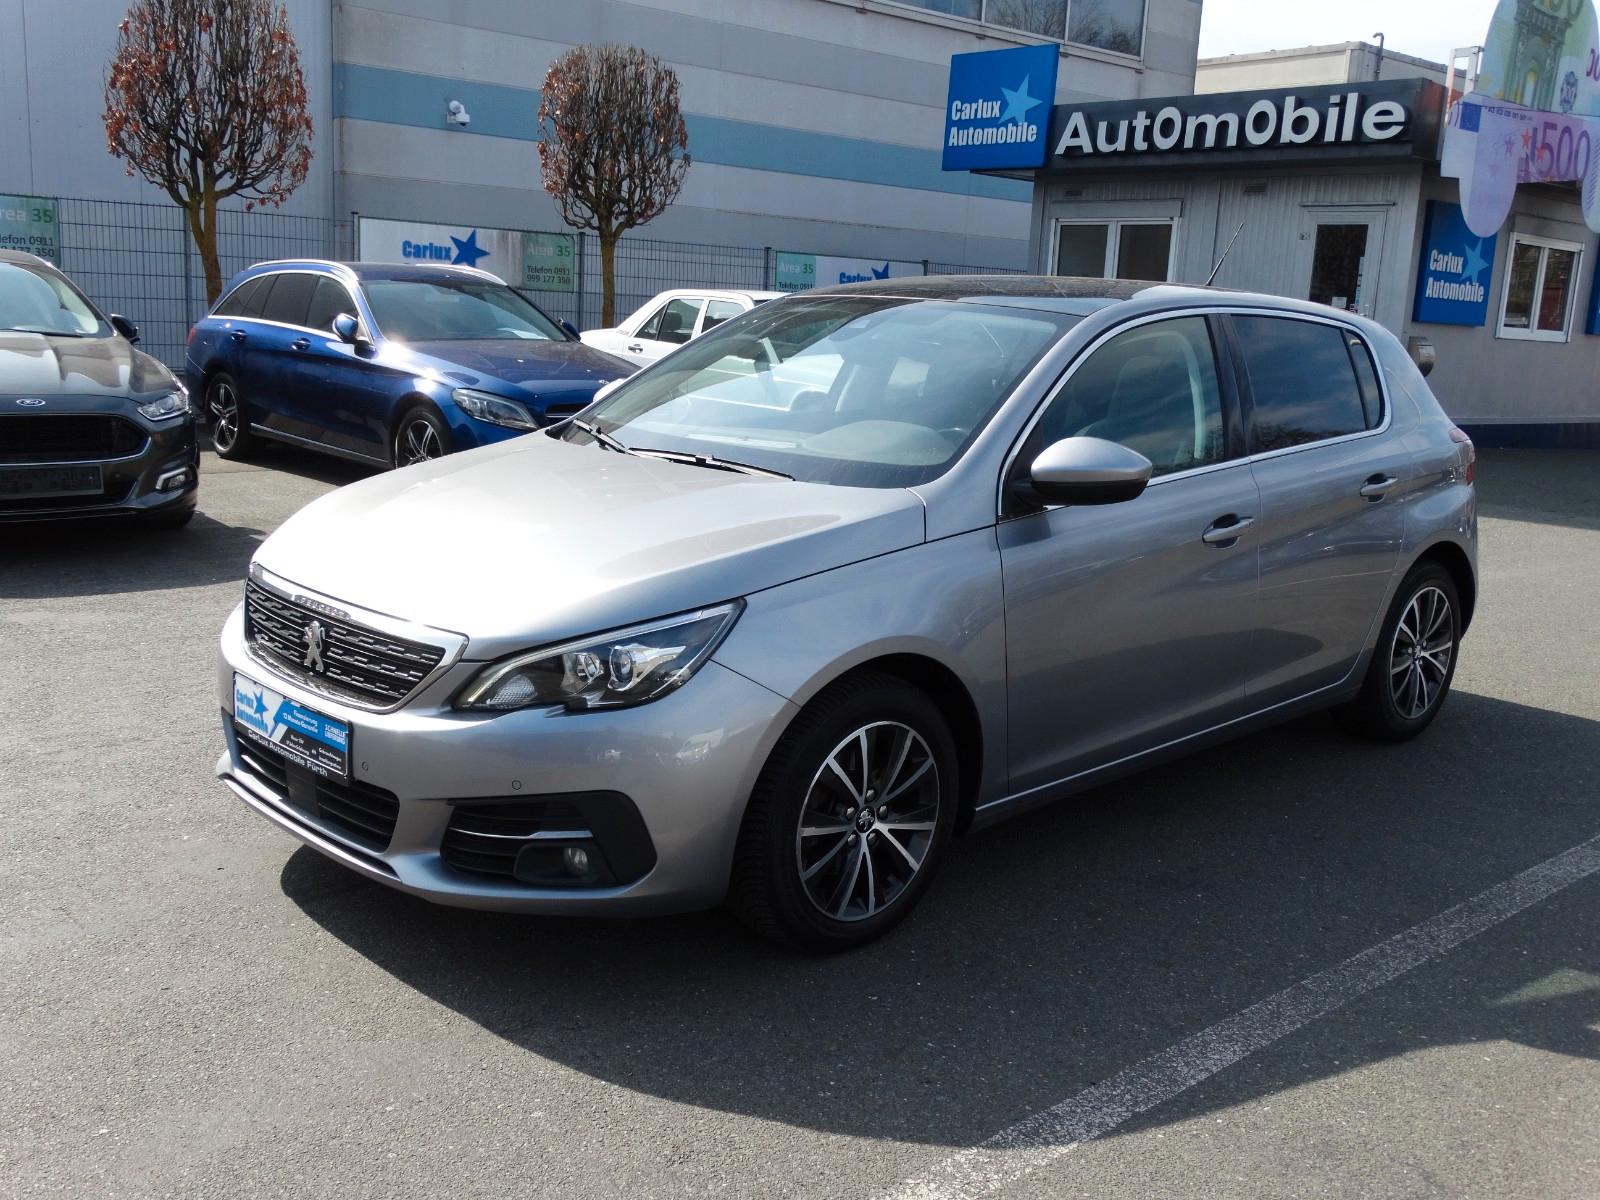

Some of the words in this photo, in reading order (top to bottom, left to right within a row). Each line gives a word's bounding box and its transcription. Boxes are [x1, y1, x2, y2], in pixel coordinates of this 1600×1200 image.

[951, 98, 1001, 121] Carlux
[948, 121, 1038, 147] Automobile
[31, 207, 53, 224] 35
[29, 235, 54, 247] 0911
[402, 240, 452, 261] Carlux
[556, 244, 571, 258] 35
[526, 264, 553, 275] Telefon
[554, 266, 571, 276] 0911
[780, 262, 800, 273] Area
[802, 263, 814, 274] 35
[1429, 248, 1465, 274] Carlux
[778, 281, 799, 290] Telefon
[1424, 276, 1486, 304] Automobile
[268, 742, 306, 767] Automobile
[305, 759, 328, 777] Fürth
